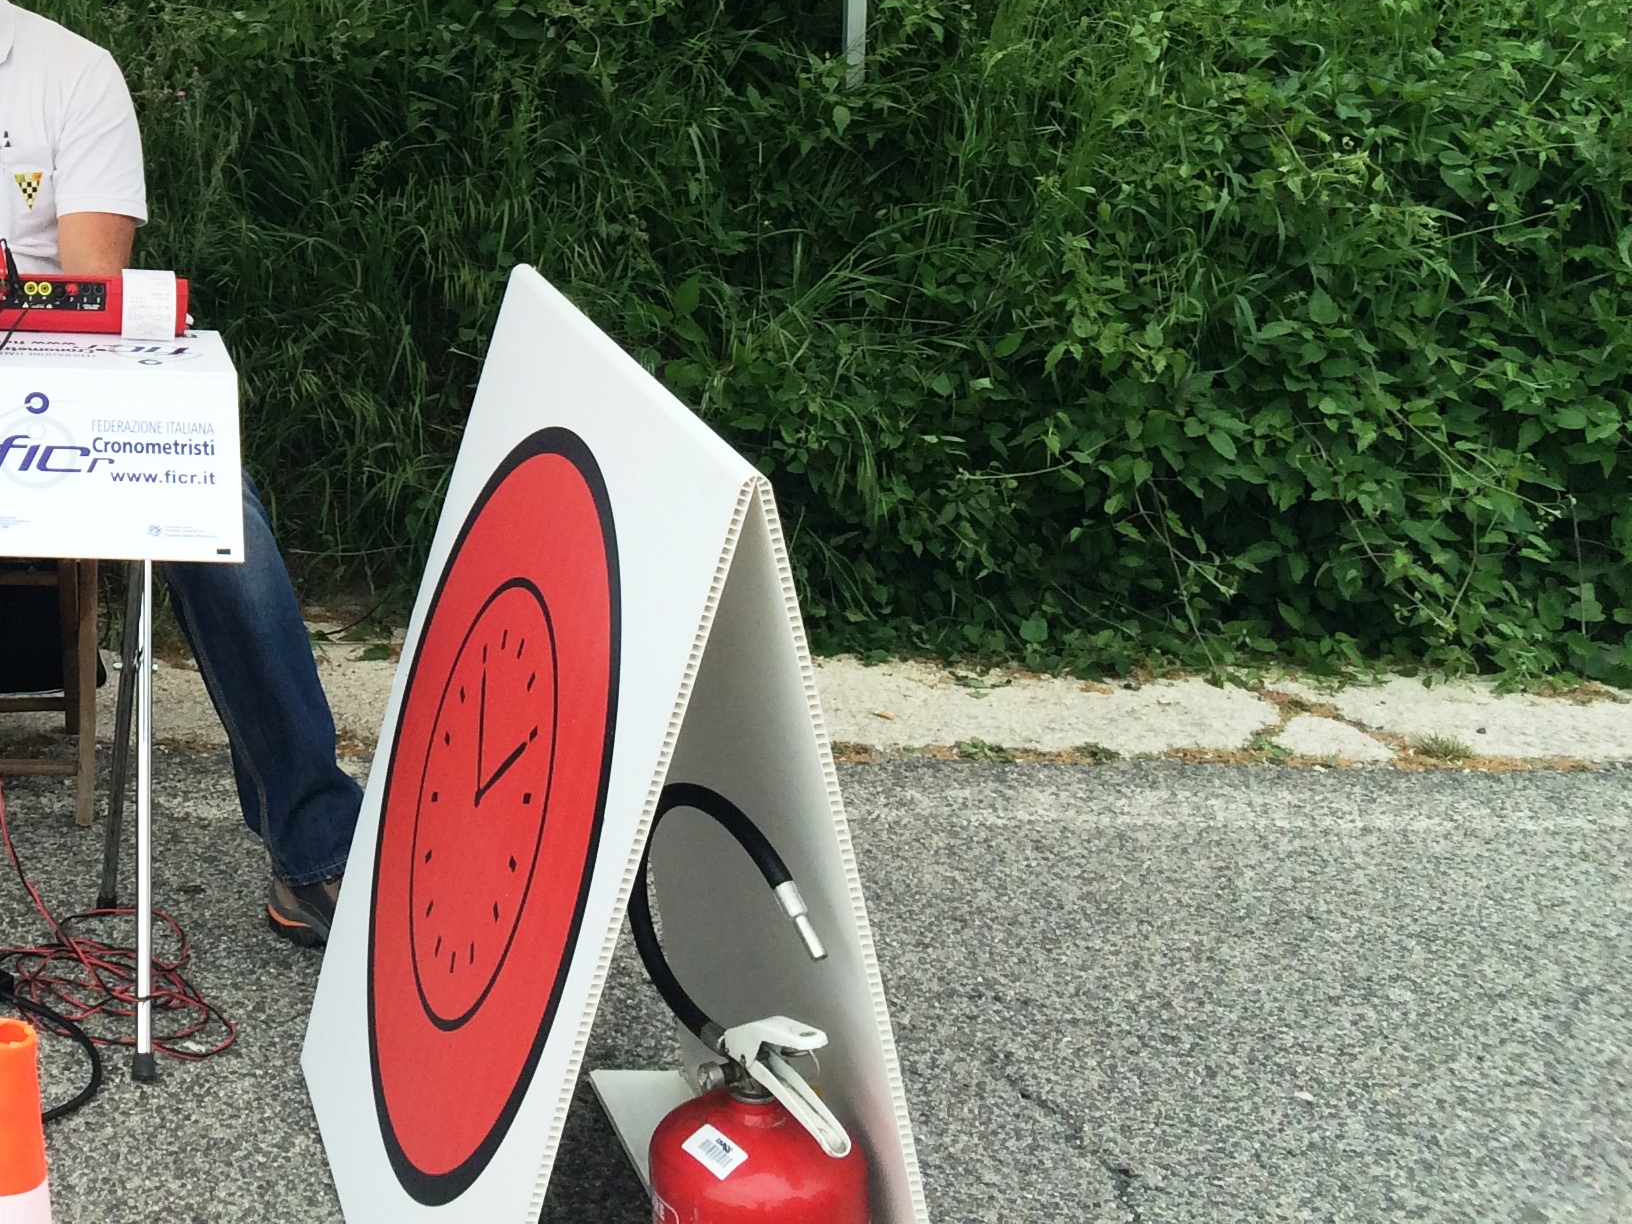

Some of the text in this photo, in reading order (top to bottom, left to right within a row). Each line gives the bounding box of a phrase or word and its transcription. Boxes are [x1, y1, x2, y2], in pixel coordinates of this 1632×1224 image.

[91, 419, 215, 435] FEDERAZIONE ITALIANA
[91, 437, 216, 456] Cronometristi
[110, 471, 216, 485] www.ficr.it
